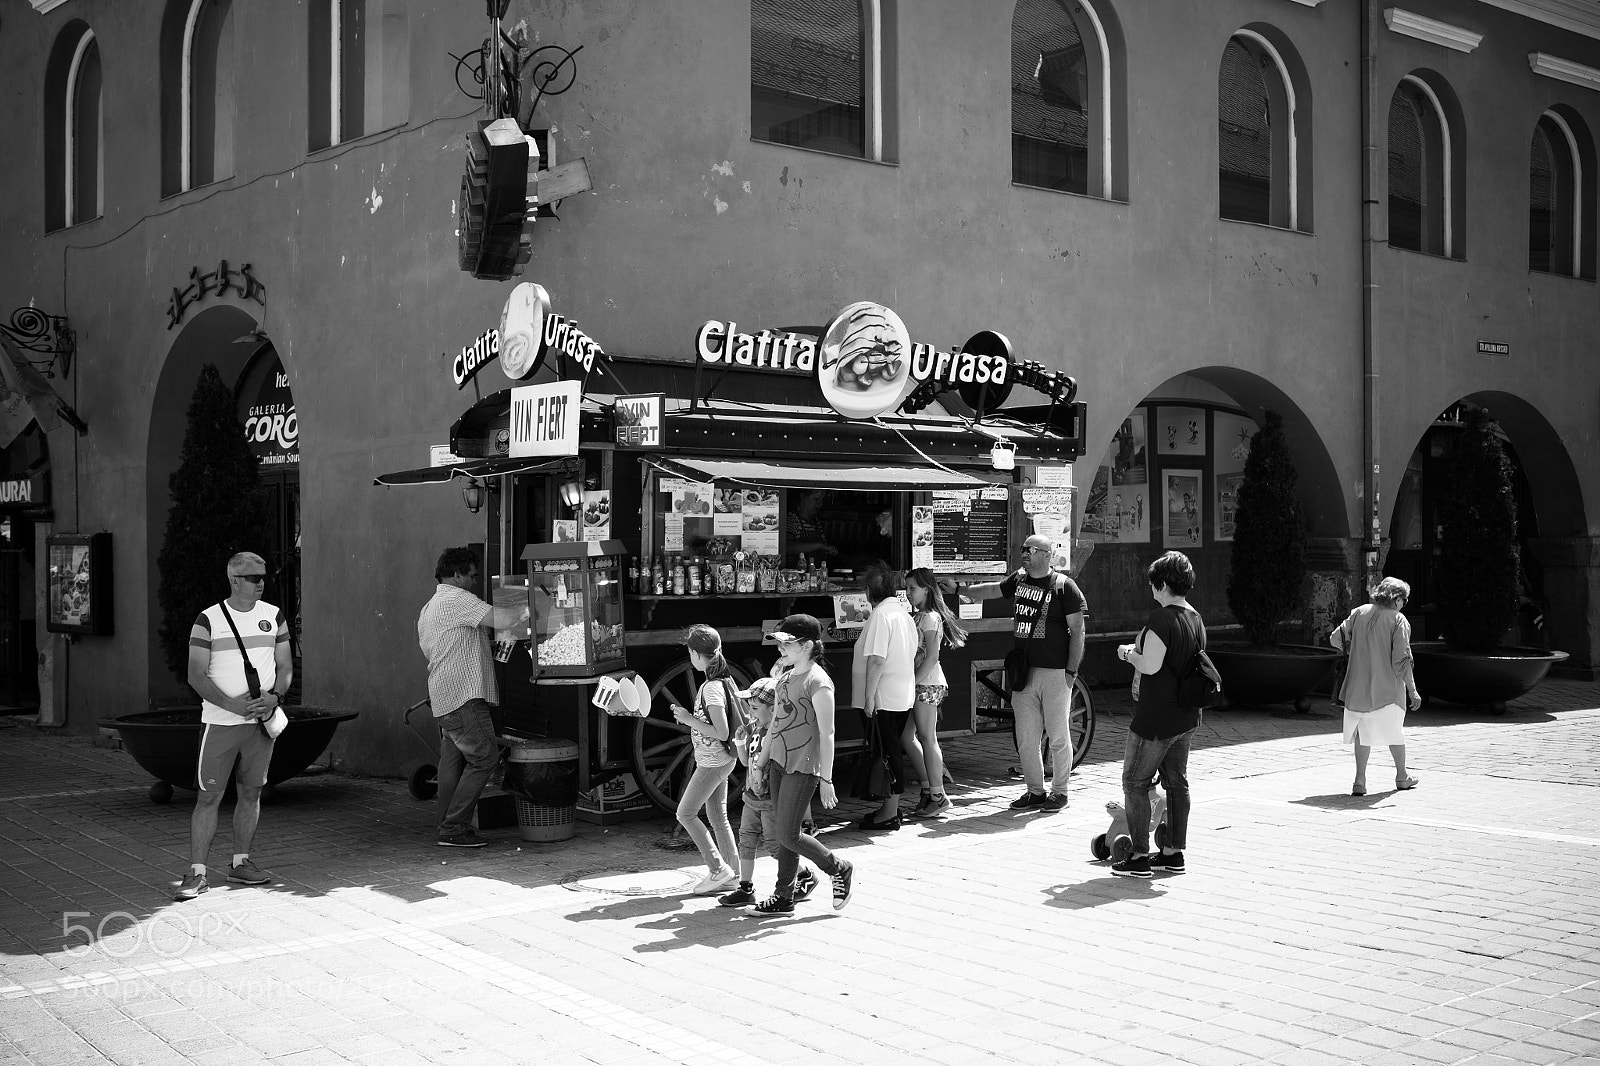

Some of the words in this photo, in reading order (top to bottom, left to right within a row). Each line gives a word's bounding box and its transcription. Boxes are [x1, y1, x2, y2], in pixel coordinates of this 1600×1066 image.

[698, 320, 816, 371] Clatita
[248, 402, 286, 417] GALERIA
[625, 402, 650, 418] VIN
[514, 398, 532, 443] VIN
[537, 394, 568, 442] FIERT
[616, 426, 659, 443] FIERT
[1016, 622, 1032, 634] JPN
[603, 779, 625, 790] Dole
